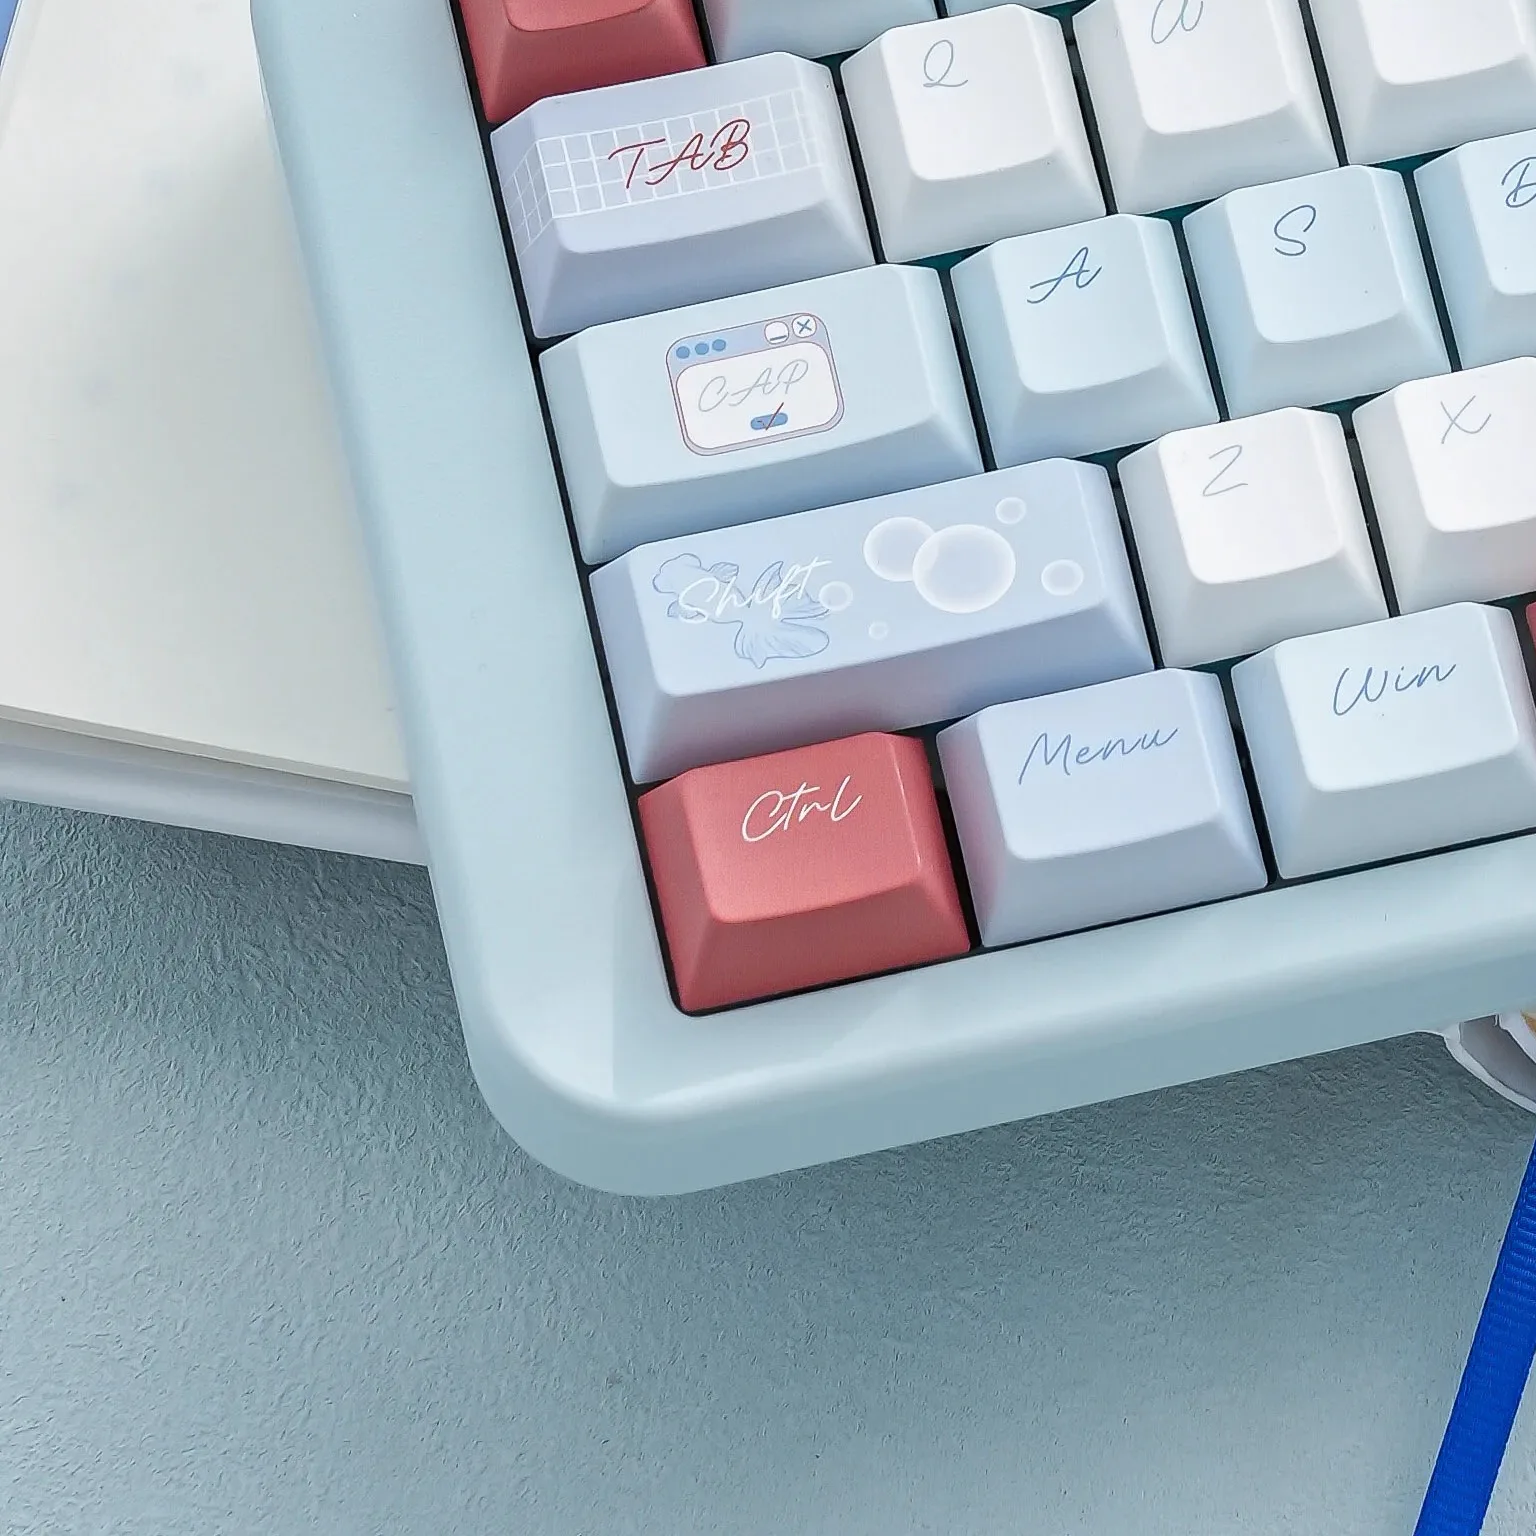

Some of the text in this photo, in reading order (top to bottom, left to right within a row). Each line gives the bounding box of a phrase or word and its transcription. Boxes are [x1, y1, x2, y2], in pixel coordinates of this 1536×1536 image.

[922, 39, 969, 89] Q
[607, 118, 752, 189] TAB
[1273, 204, 1317, 257] S
[1026, 246, 1103, 305] A
[697, 358, 810, 413] CAP
[1439, 394, 1494, 445] X
[1201, 444, 1250, 498] Z
[677, 556, 833, 624] Shift
[1332, 663, 1458, 717] Win
[1017, 726, 1179, 786] Menu
[740, 775, 864, 843] Ctrl
